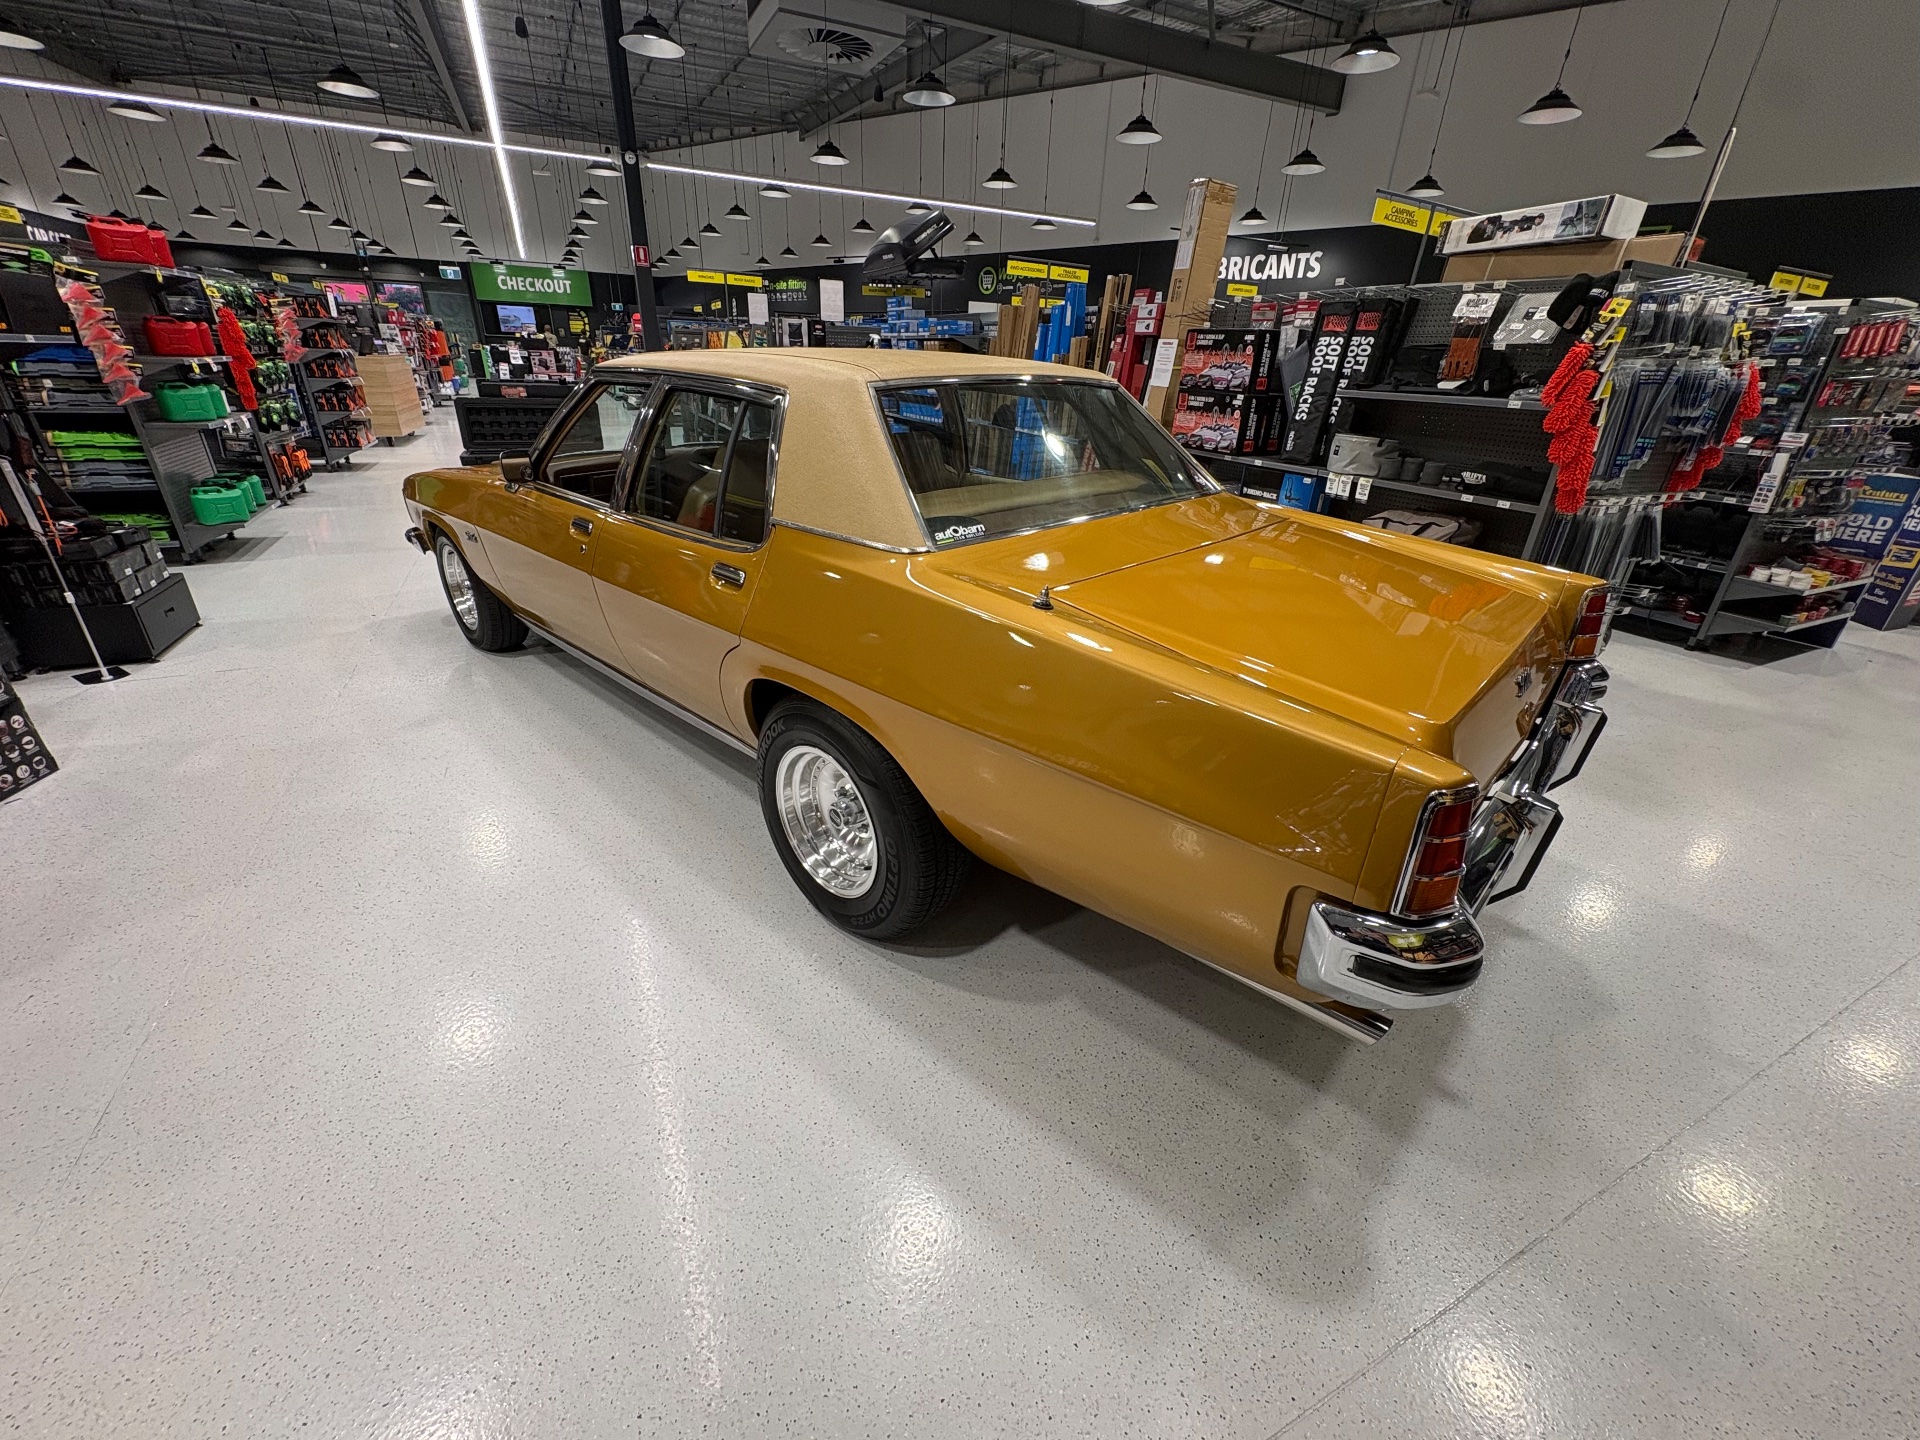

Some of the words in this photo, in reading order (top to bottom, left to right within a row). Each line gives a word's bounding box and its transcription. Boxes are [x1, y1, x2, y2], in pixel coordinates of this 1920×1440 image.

[1384, 213, 1418, 227] ACCESSORIES
[1391, 206, 1415, 218] CAMPING
[1218, 251, 1323, 280] BRICANTS
[497, 275, 571, 293] CHECKOUT
[768, 280, 787, 290] n-site
[788, 279, 807, 291] fitting
[1310, 336, 1330, 374] ROOF
[1322, 336, 1344, 371] SOFT
[1342, 336, 1361, 376] ROOF
[1353, 336, 1374, 372] SOFT
[1295, 377, 1318, 421] RACKS
[1328, 379, 1348, 424] RCKS
[1247, 488, 1277, 500] RHINO-RACK
[877, 836, 899, 918] OPTIMO
